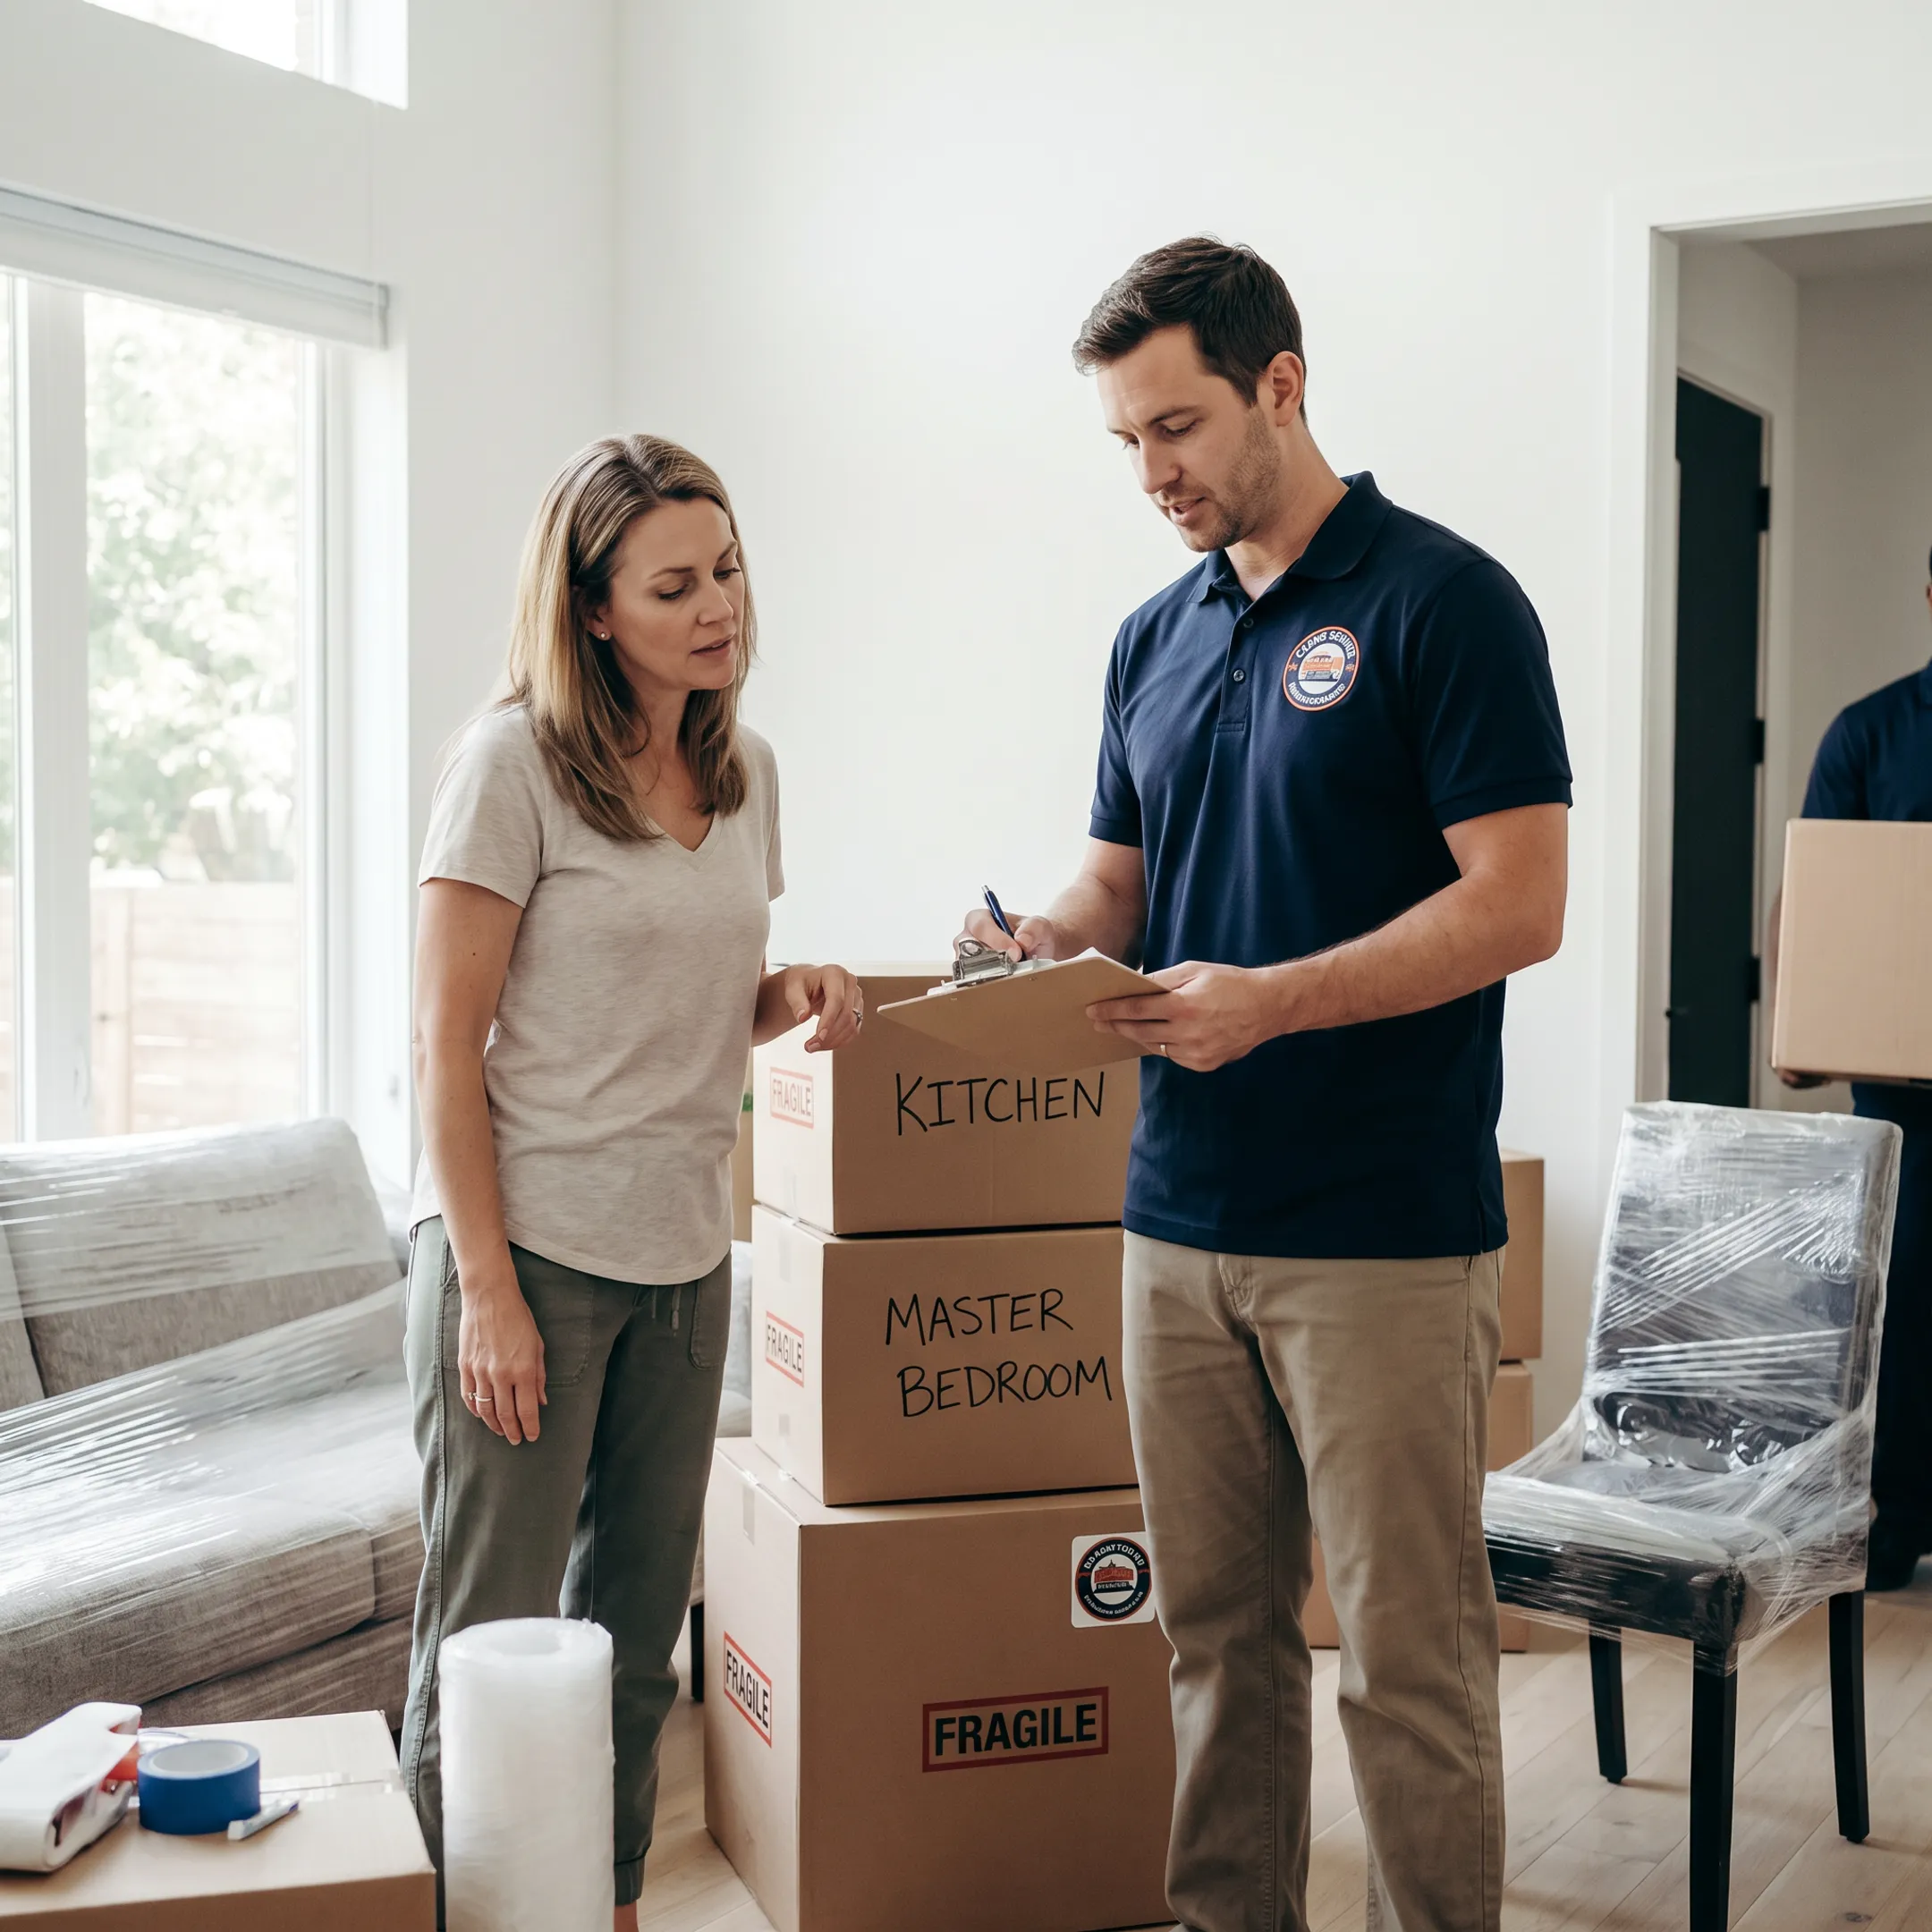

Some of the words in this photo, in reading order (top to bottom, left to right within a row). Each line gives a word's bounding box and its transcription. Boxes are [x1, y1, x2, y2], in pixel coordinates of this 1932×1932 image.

[772, 1078, 811, 1116] FRAGILE
[895, 1071, 1105, 1137] KITCHEN
[885, 1288, 1074, 1346] MASTER
[767, 1324, 802, 1373] FRAGILE
[896, 1355, 1113, 1418] BEDROOM
[726, 1648, 769, 1729] FRAGILE
[934, 1703, 1097, 1757] FRAGILE
